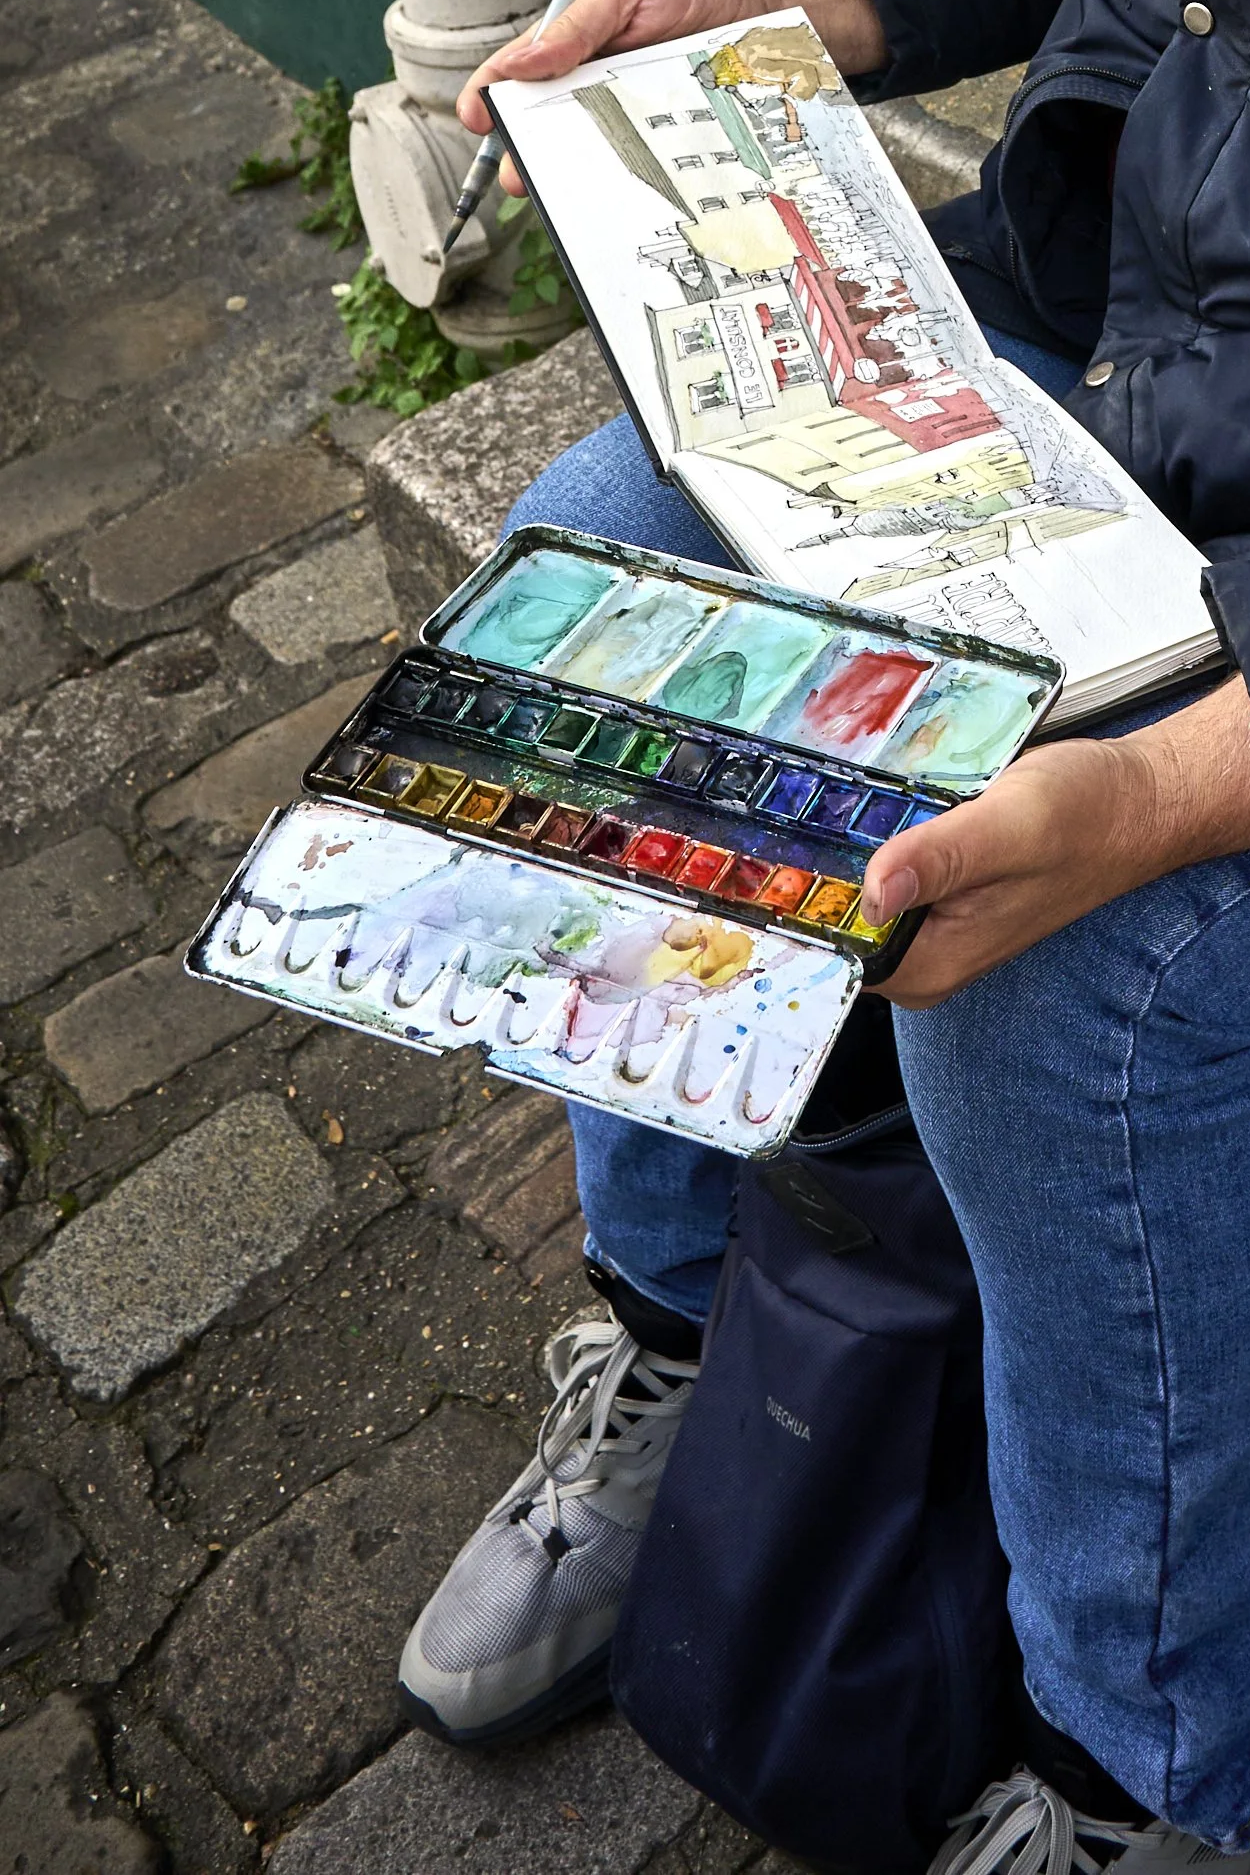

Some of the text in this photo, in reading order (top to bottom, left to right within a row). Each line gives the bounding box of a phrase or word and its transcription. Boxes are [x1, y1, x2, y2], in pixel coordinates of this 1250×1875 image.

[719, 307, 764, 404] LE CONSULAT
[765, 1395, 812, 1442] QUECHUA
